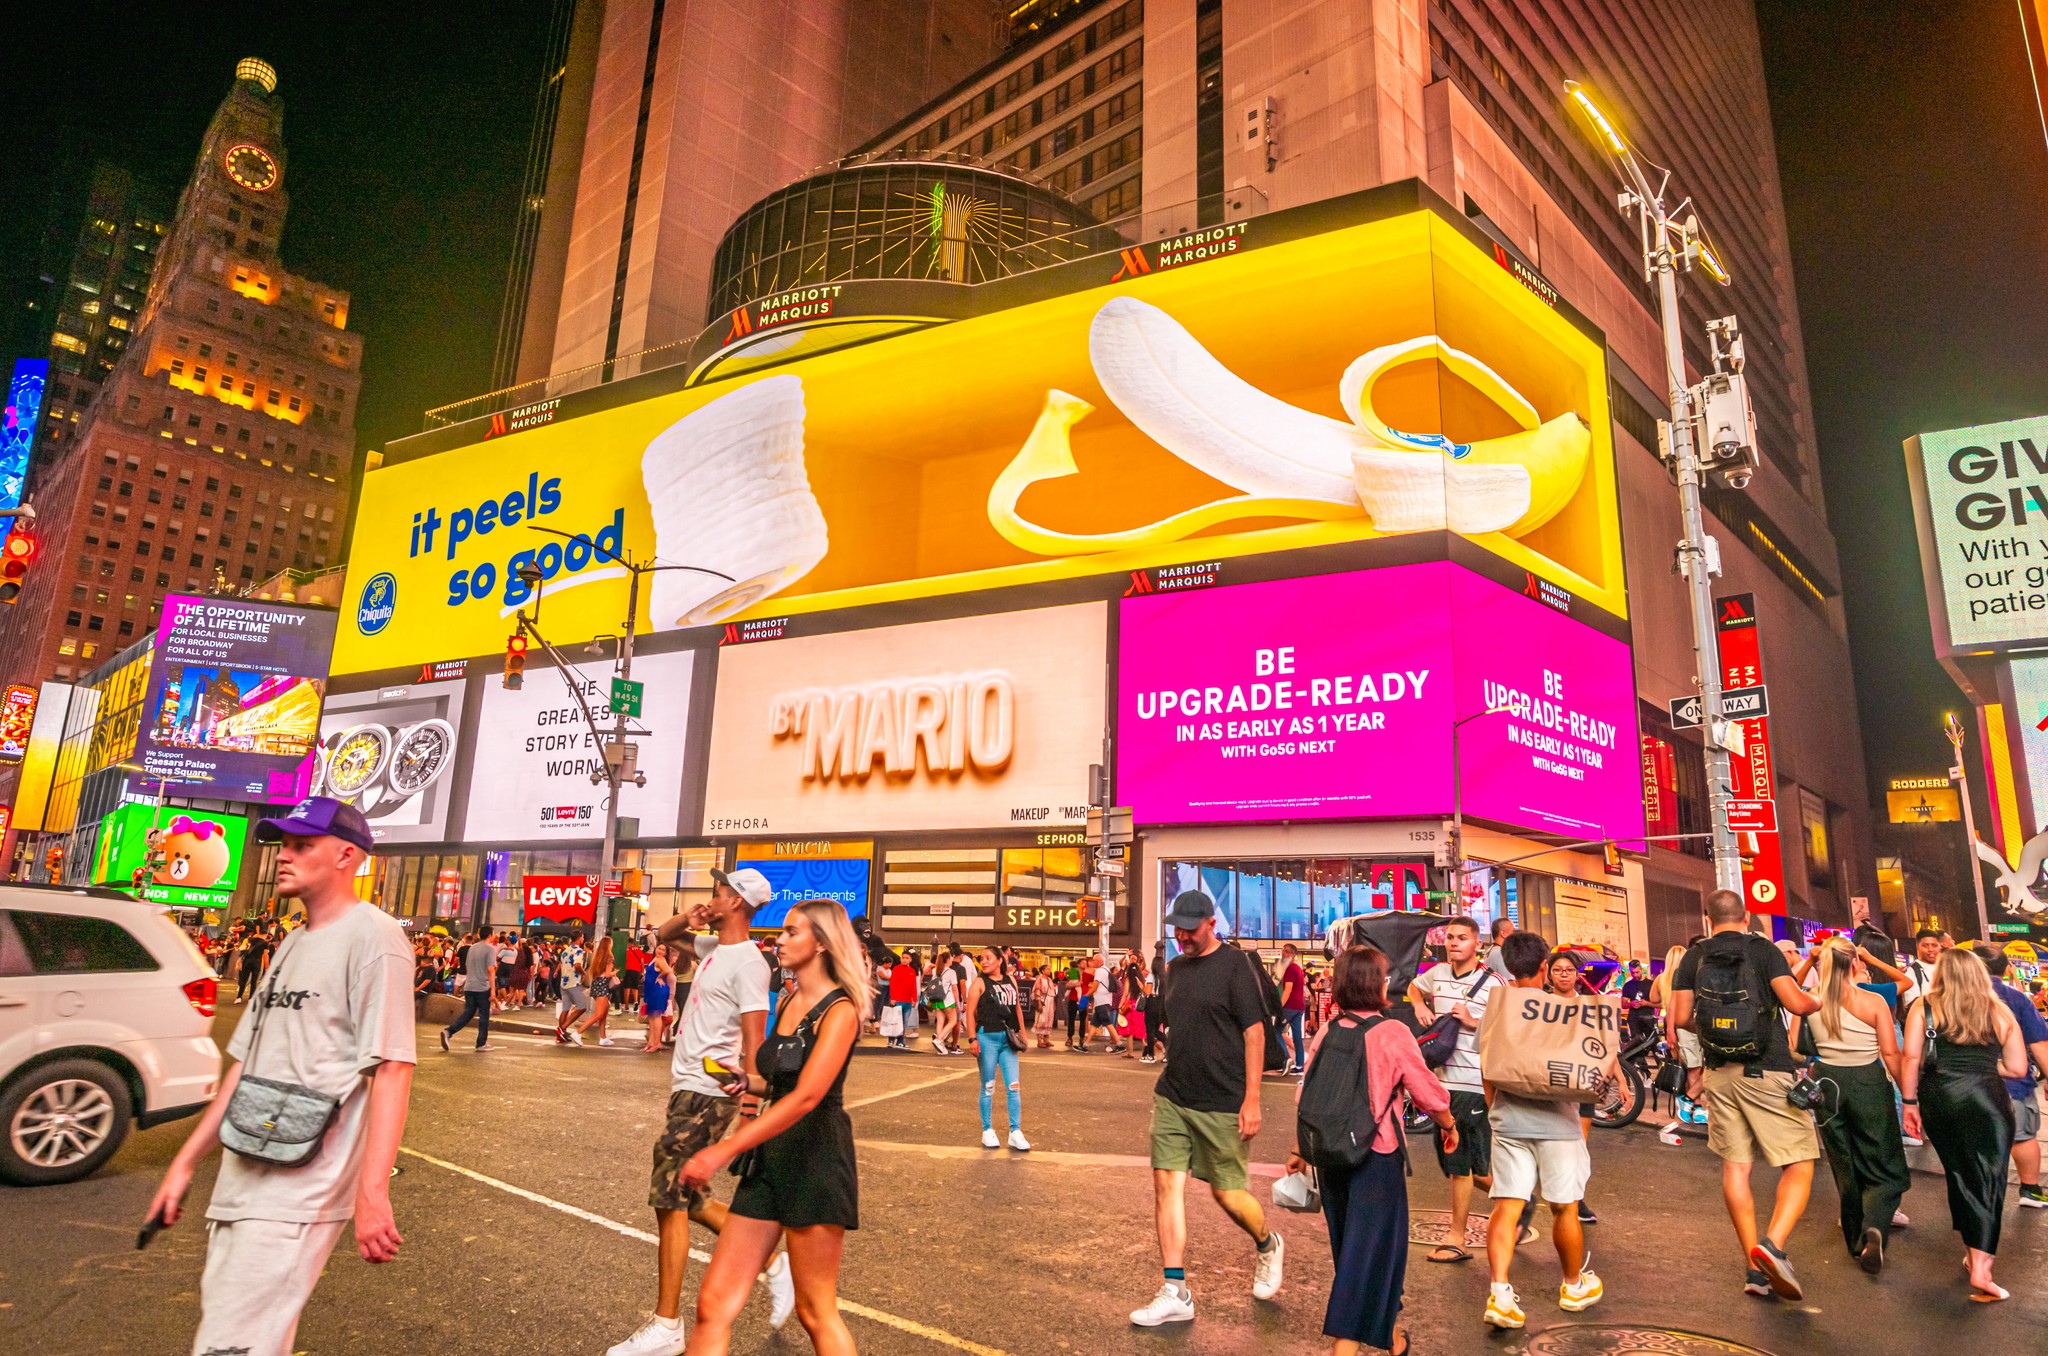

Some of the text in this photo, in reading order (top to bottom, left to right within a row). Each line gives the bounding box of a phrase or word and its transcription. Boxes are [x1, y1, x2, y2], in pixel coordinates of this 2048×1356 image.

[1160, 222, 1248, 252] MARRIOTT
[1159, 238, 1238, 267] MARQUIS
[1515, 260, 1557, 303] MARRIOTT
[760, 285, 842, 312] MARRIOTT
[759, 301, 831, 328] MARQUIS
[512, 399, 561, 419] MARRIOTT
[510, 412, 553, 431] MARQUIS
[410, 471, 562, 560] it peels
[447, 507, 625, 607] so good
[1959, 537, 2029, 563] With
[1159, 562, 1222, 578] MARRIOTT
[1965, 566, 2014, 588] our
[1159, 574, 1214, 590] MARQUIS
[1540, 580, 1571, 602] MARRIOTT
[1541, 591, 1569, 612] MARQUIS
[177, 603, 306, 626] THE OPPORTUNITY
[358, 605, 393, 625] Chiquita
[1725, 616, 1755, 626] MARRIOTT
[174, 615, 271, 634] OF A LIFETIME
[744, 618, 789, 631] MARRIOTT
[171, 627, 268, 643] FOR LOCAL BUSINESSES
[743, 628, 782, 640] MARQUIS
[167, 646, 184, 655] FOR
[185, 648, 201, 656] ALL
[202, 649, 213, 657] OF
[169, 637, 233, 650] FOR BROADWAY
[165, 657, 206, 666] ENTERTAINMENT
[435, 660, 468, 671] MARRIOTT
[1255, 646, 1295, 677] BE
[434, 668, 463, 679] MARQUIS
[567, 680, 597, 698] THE
[623, 683, 632, 692] TO
[1543, 668, 1562, 700] BE
[621, 693, 630, 702] 45
[631, 694, 638, 703] St
[1136, 669, 1430, 720] UPGRADE-READY
[1483, 679, 1616, 750] UPGRADE-READY
[1685, 696, 1753, 718] ON WAY
[771, 678, 1013, 780] BY MARIO
[1176, 711, 1385, 742] IN AS EARLY AS 1 YEAR
[525, 733, 578, 752] STORY
[1221, 740, 1336, 759] WITH Go5G NEXT
[1508, 723, 1602, 770] IN AS EARLY AS 1 YEAR
[144, 757, 217, 770] Caesars Palace
[157, 750, 184, 759] Support
[144, 765, 208, 777] Times Square
[546, 758, 598, 777] WORN
[1532, 755, 1584, 782] WITH Go5G NEXT
[1892, 778, 1949, 790] RODGERS
[541, 806, 556, 821] 501
[1010, 807, 1050, 821] MAKEUP
[1729, 810, 1751, 818] Anytime
[710, 817, 770, 831] SEPHORA
[1408, 830, 1436, 842] 1535
[775, 840, 832, 855] INVICTA
[184, 892, 210, 902] NEW
[782, 889, 803, 901] The
[804, 889, 856, 901] Elements
[1997, 925, 2027, 933] Broadway
[1715, 1018, 1732, 1028] CAT
